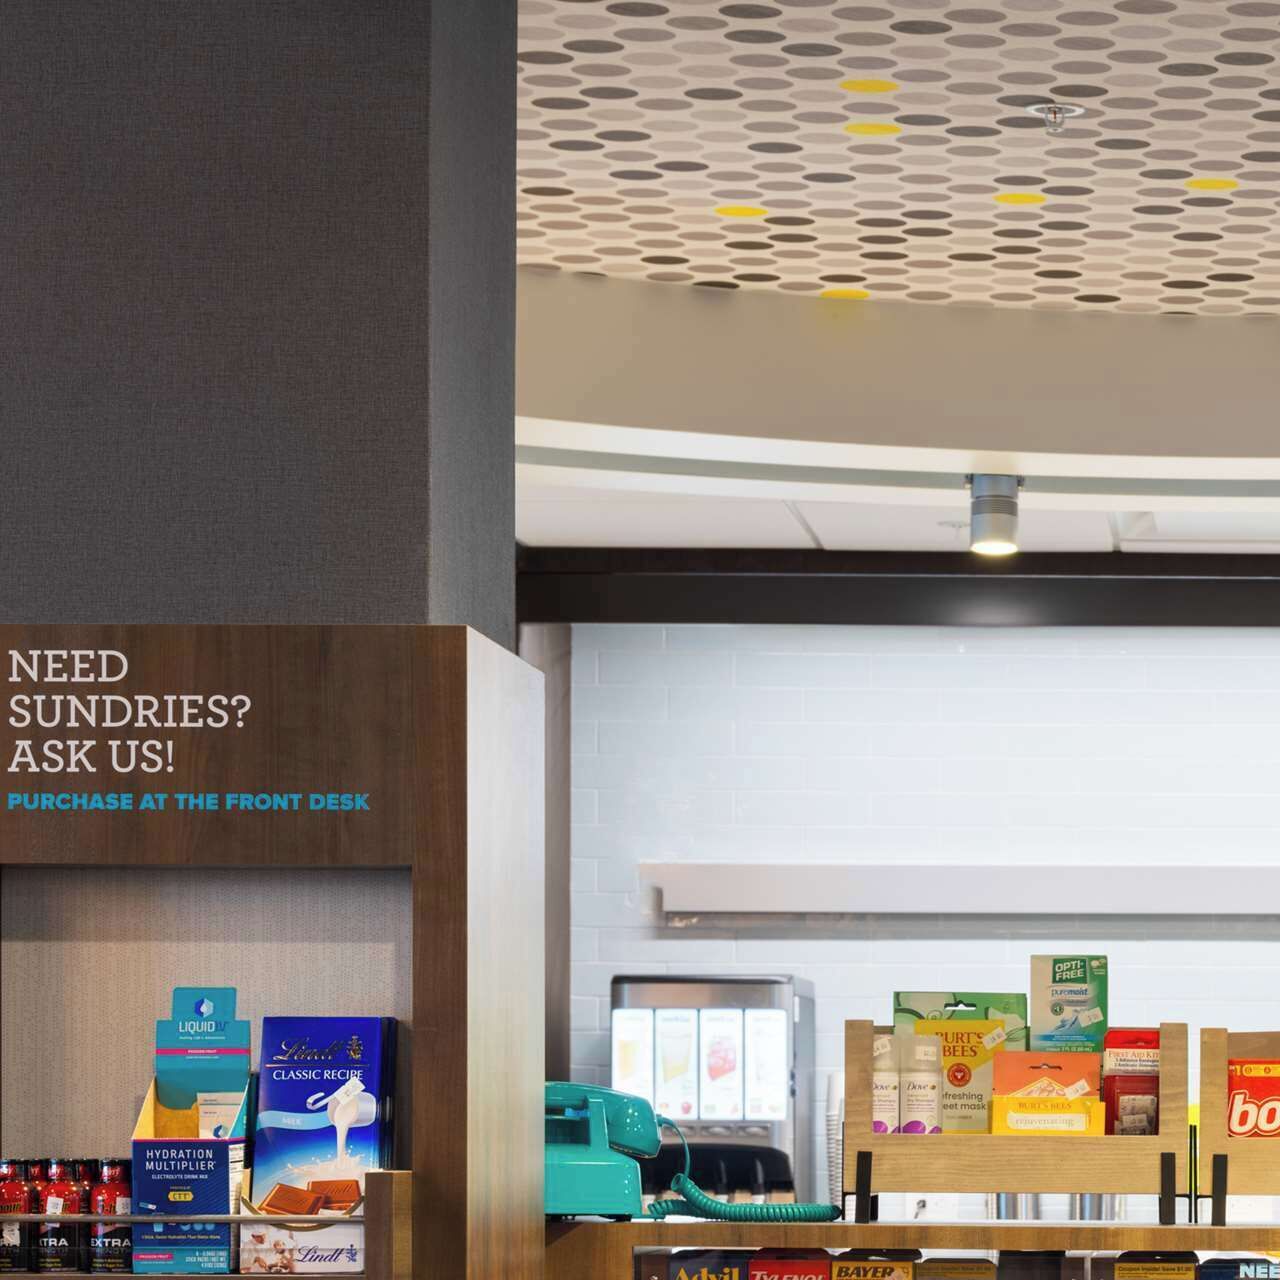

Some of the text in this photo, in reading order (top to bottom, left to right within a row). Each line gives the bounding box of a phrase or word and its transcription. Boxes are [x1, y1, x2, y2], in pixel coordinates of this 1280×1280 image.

[8, 649, 129, 682] NEED
[8, 695, 251, 728] SUNDRIES?
[8, 740, 175, 773] ASK US!
[7, 793, 370, 810] PURCHASE AT THE FRONT DESK
[1055, 961, 1085, 973] OPTI-
[1055, 970, 1085, 981] FREE
[178, 1020, 215, 1033] LIQUID
[942, 1044, 978, 1058] BEES
[272, 1067, 364, 1081] CLASSIC RECIPE
[905, 1082, 931, 1093] Dove
[146, 1149, 213, 1159] HYDRATION
[145, 1161, 214, 1171] MULTIPLIER
[91, 1238, 132, 1247] EXTRA
[296, 1244, 344, 1263] Lindt
[836, 1266, 895, 1278] BAYER
